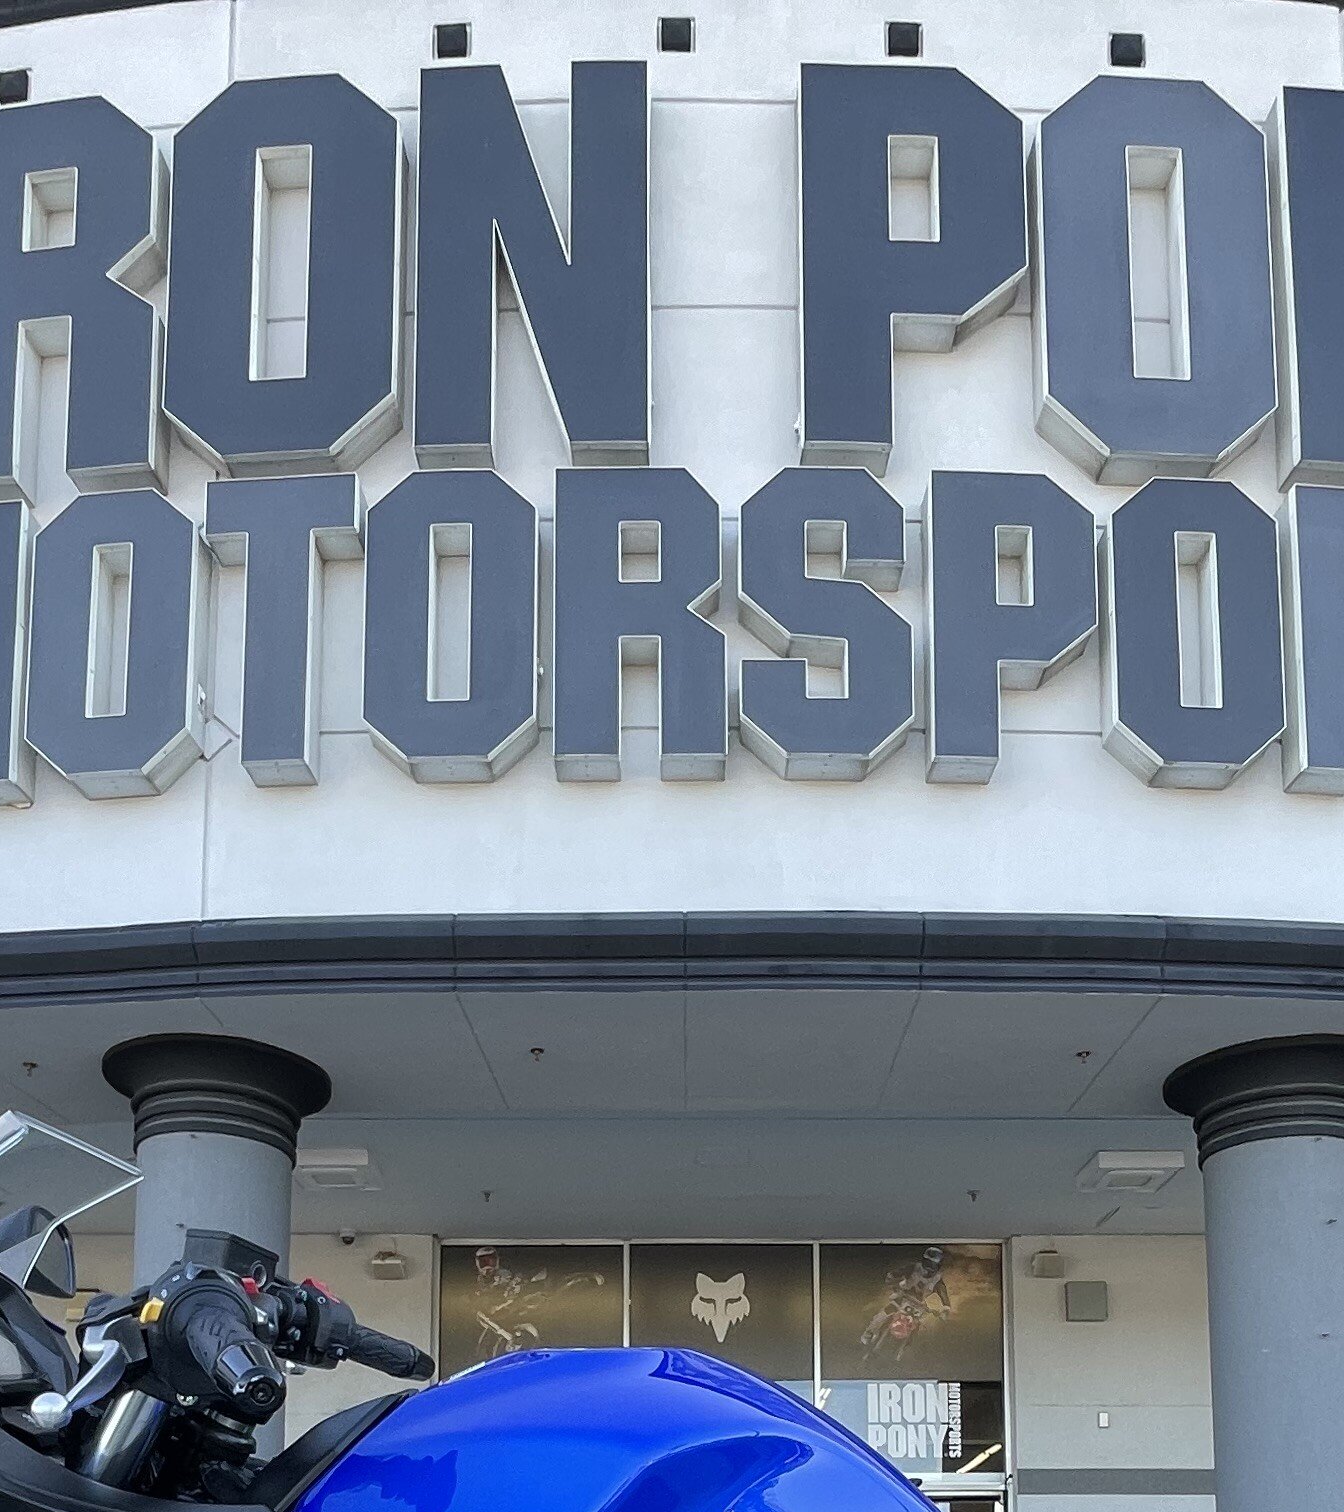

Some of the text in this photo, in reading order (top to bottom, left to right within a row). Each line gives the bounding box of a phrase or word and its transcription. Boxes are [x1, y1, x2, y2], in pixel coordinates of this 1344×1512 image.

[867, 1382, 949, 1423] IRON
[948, 1382, 962, 1459] MOTORSPORTS
[867, 1424, 949, 1458] PONY
